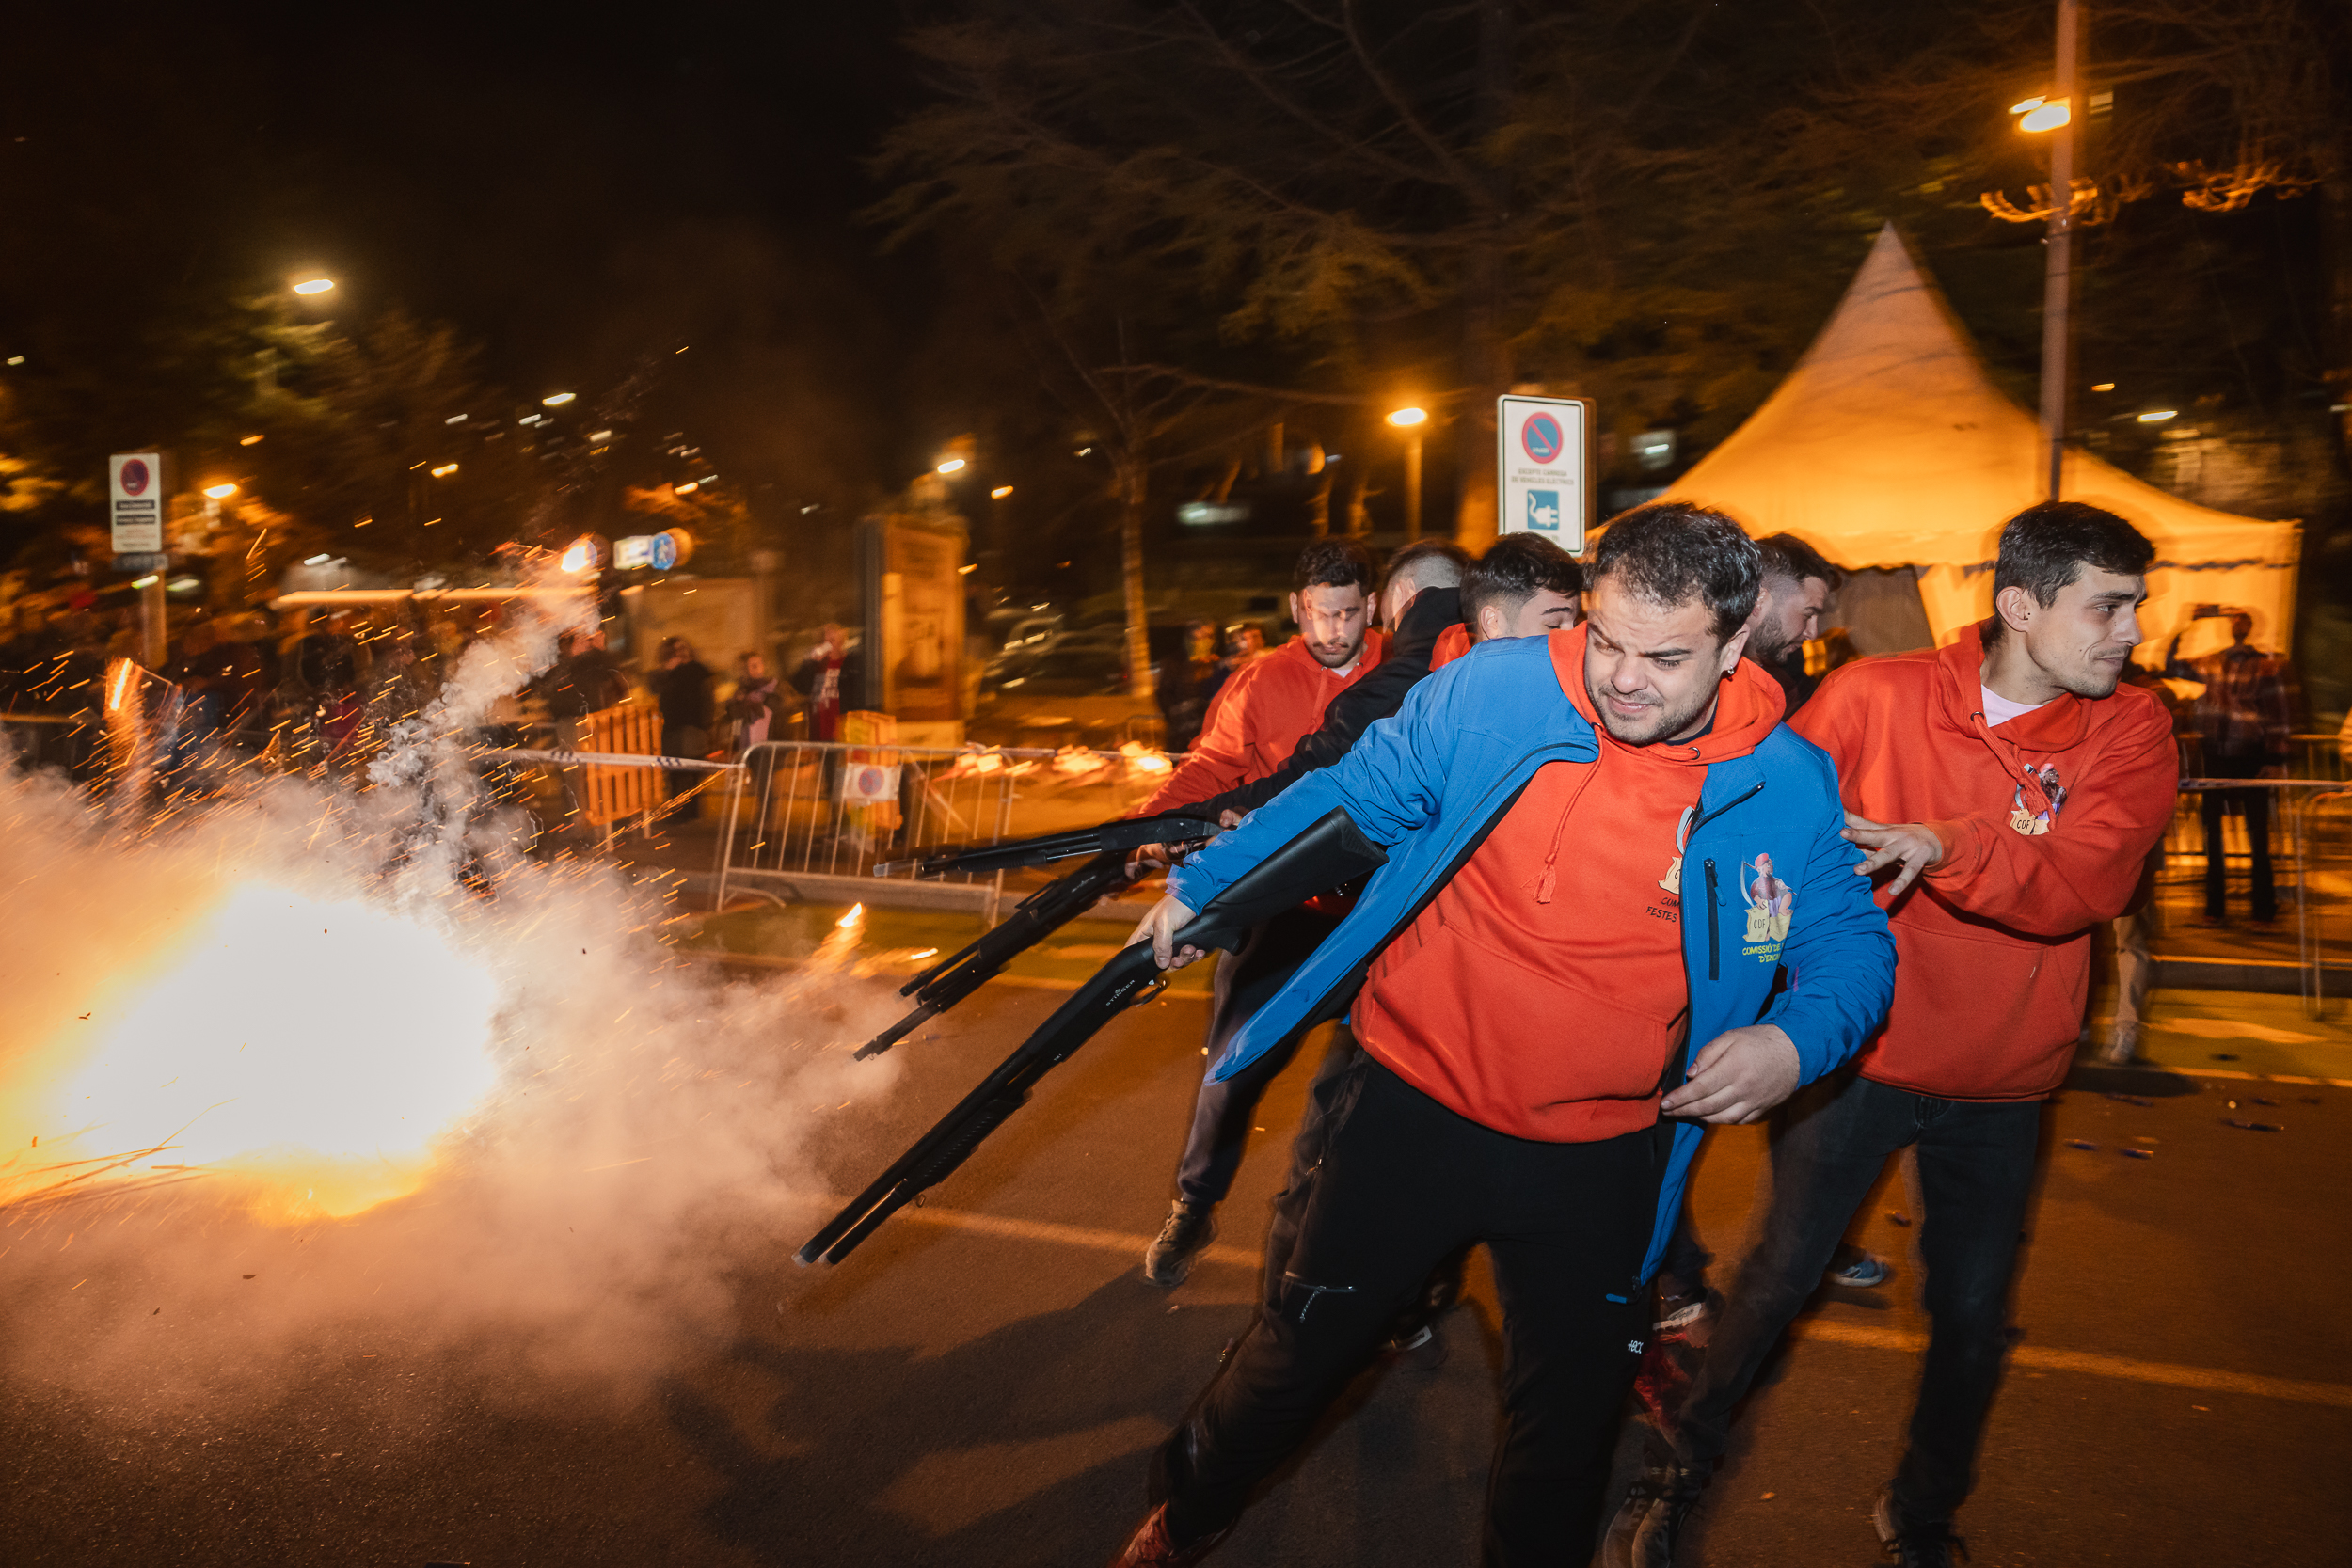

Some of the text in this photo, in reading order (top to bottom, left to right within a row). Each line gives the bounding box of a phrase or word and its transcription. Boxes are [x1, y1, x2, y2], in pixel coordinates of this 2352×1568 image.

[2016, 819, 2031, 830] CDF
[1646, 906, 1677, 923] FESTES
[1754, 918, 1766, 929] CDF
[1742, 943, 1772, 956] COMISSIÓ
[1772, 943, 1781, 952] DE
